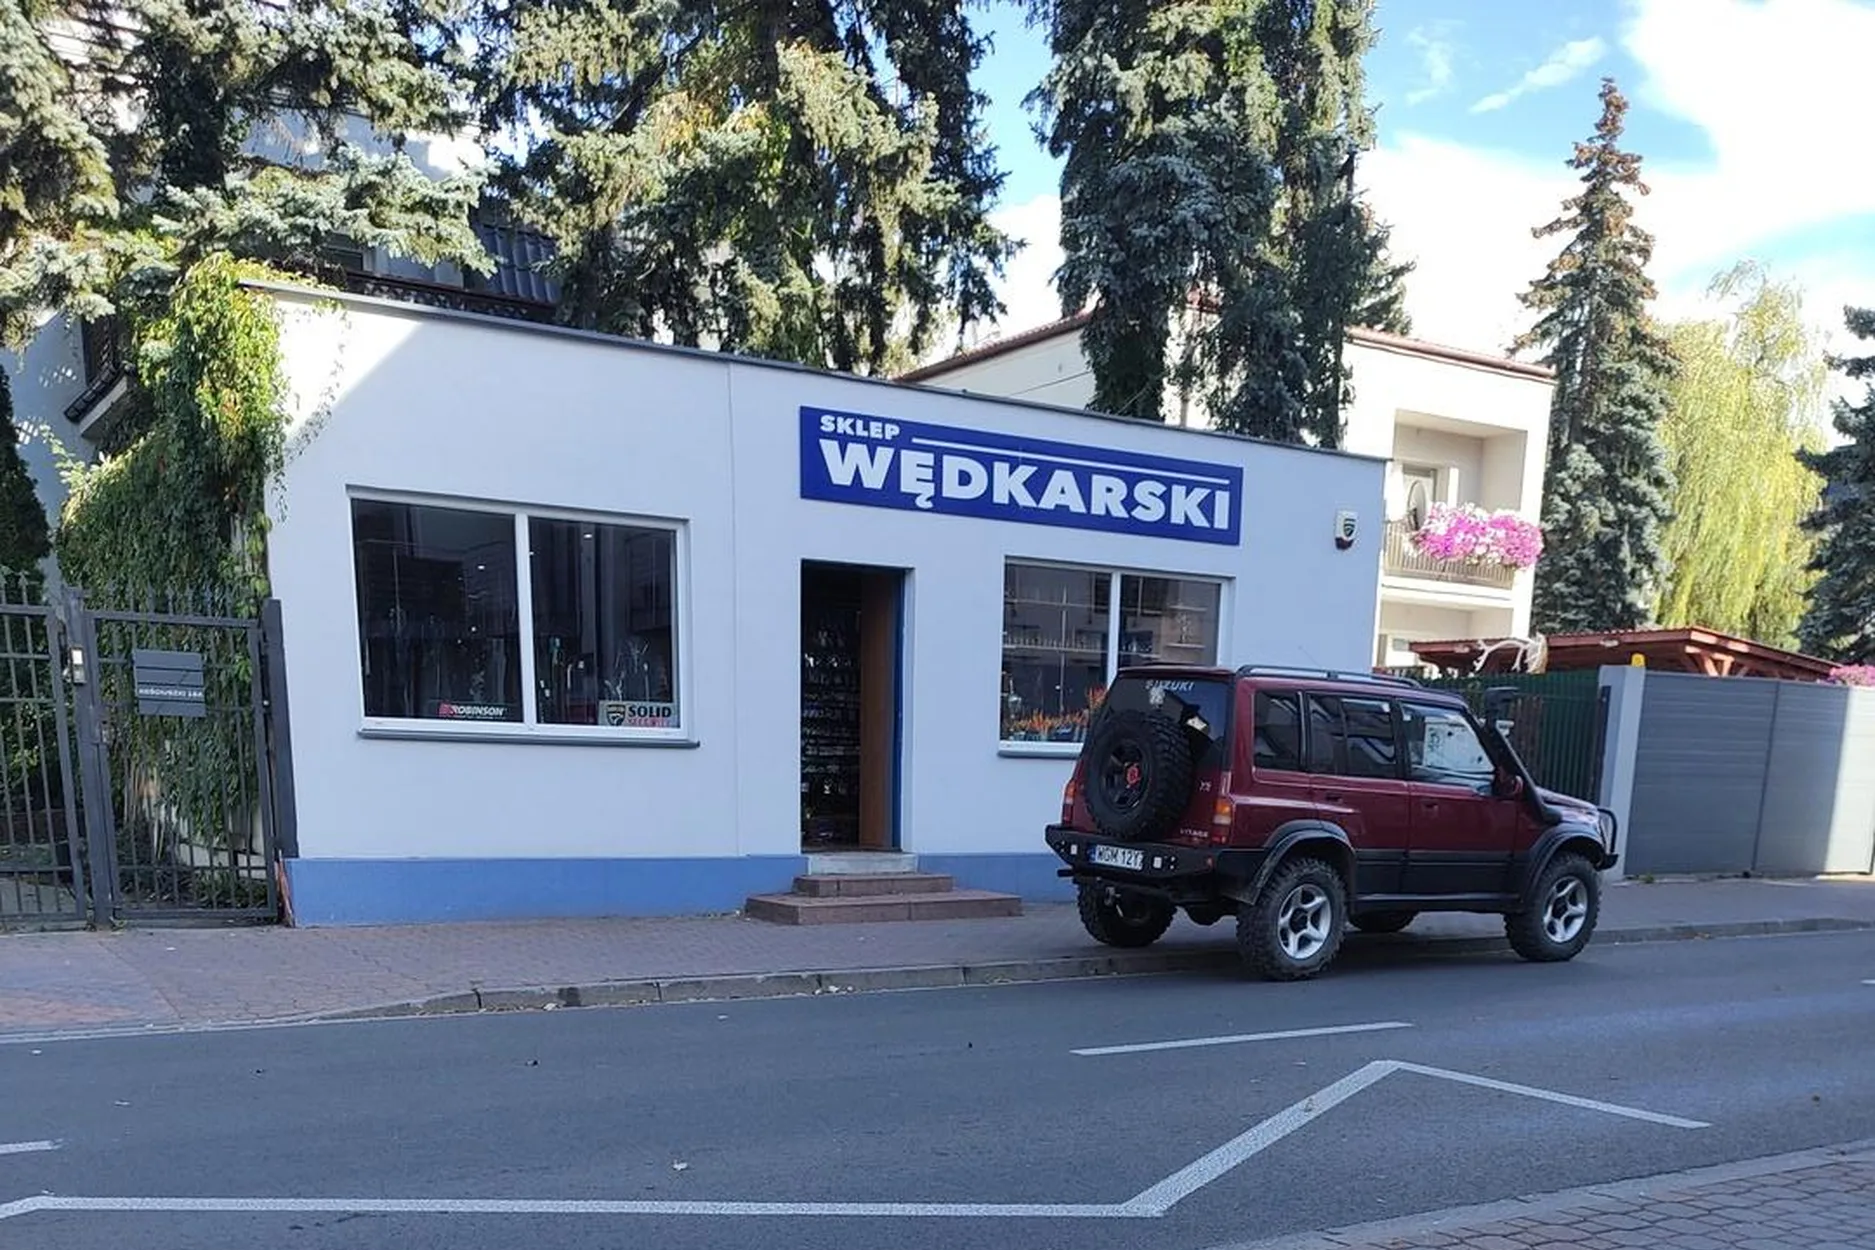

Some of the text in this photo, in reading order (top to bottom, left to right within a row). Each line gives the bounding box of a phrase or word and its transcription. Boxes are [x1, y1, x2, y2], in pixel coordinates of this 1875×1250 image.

[820, 414, 901, 440] SKLEP
[818, 438, 1231, 531] WĘDKARSKI
[1145, 679, 1195, 691] SUZUKI
[627, 704, 672, 718] SOLID
